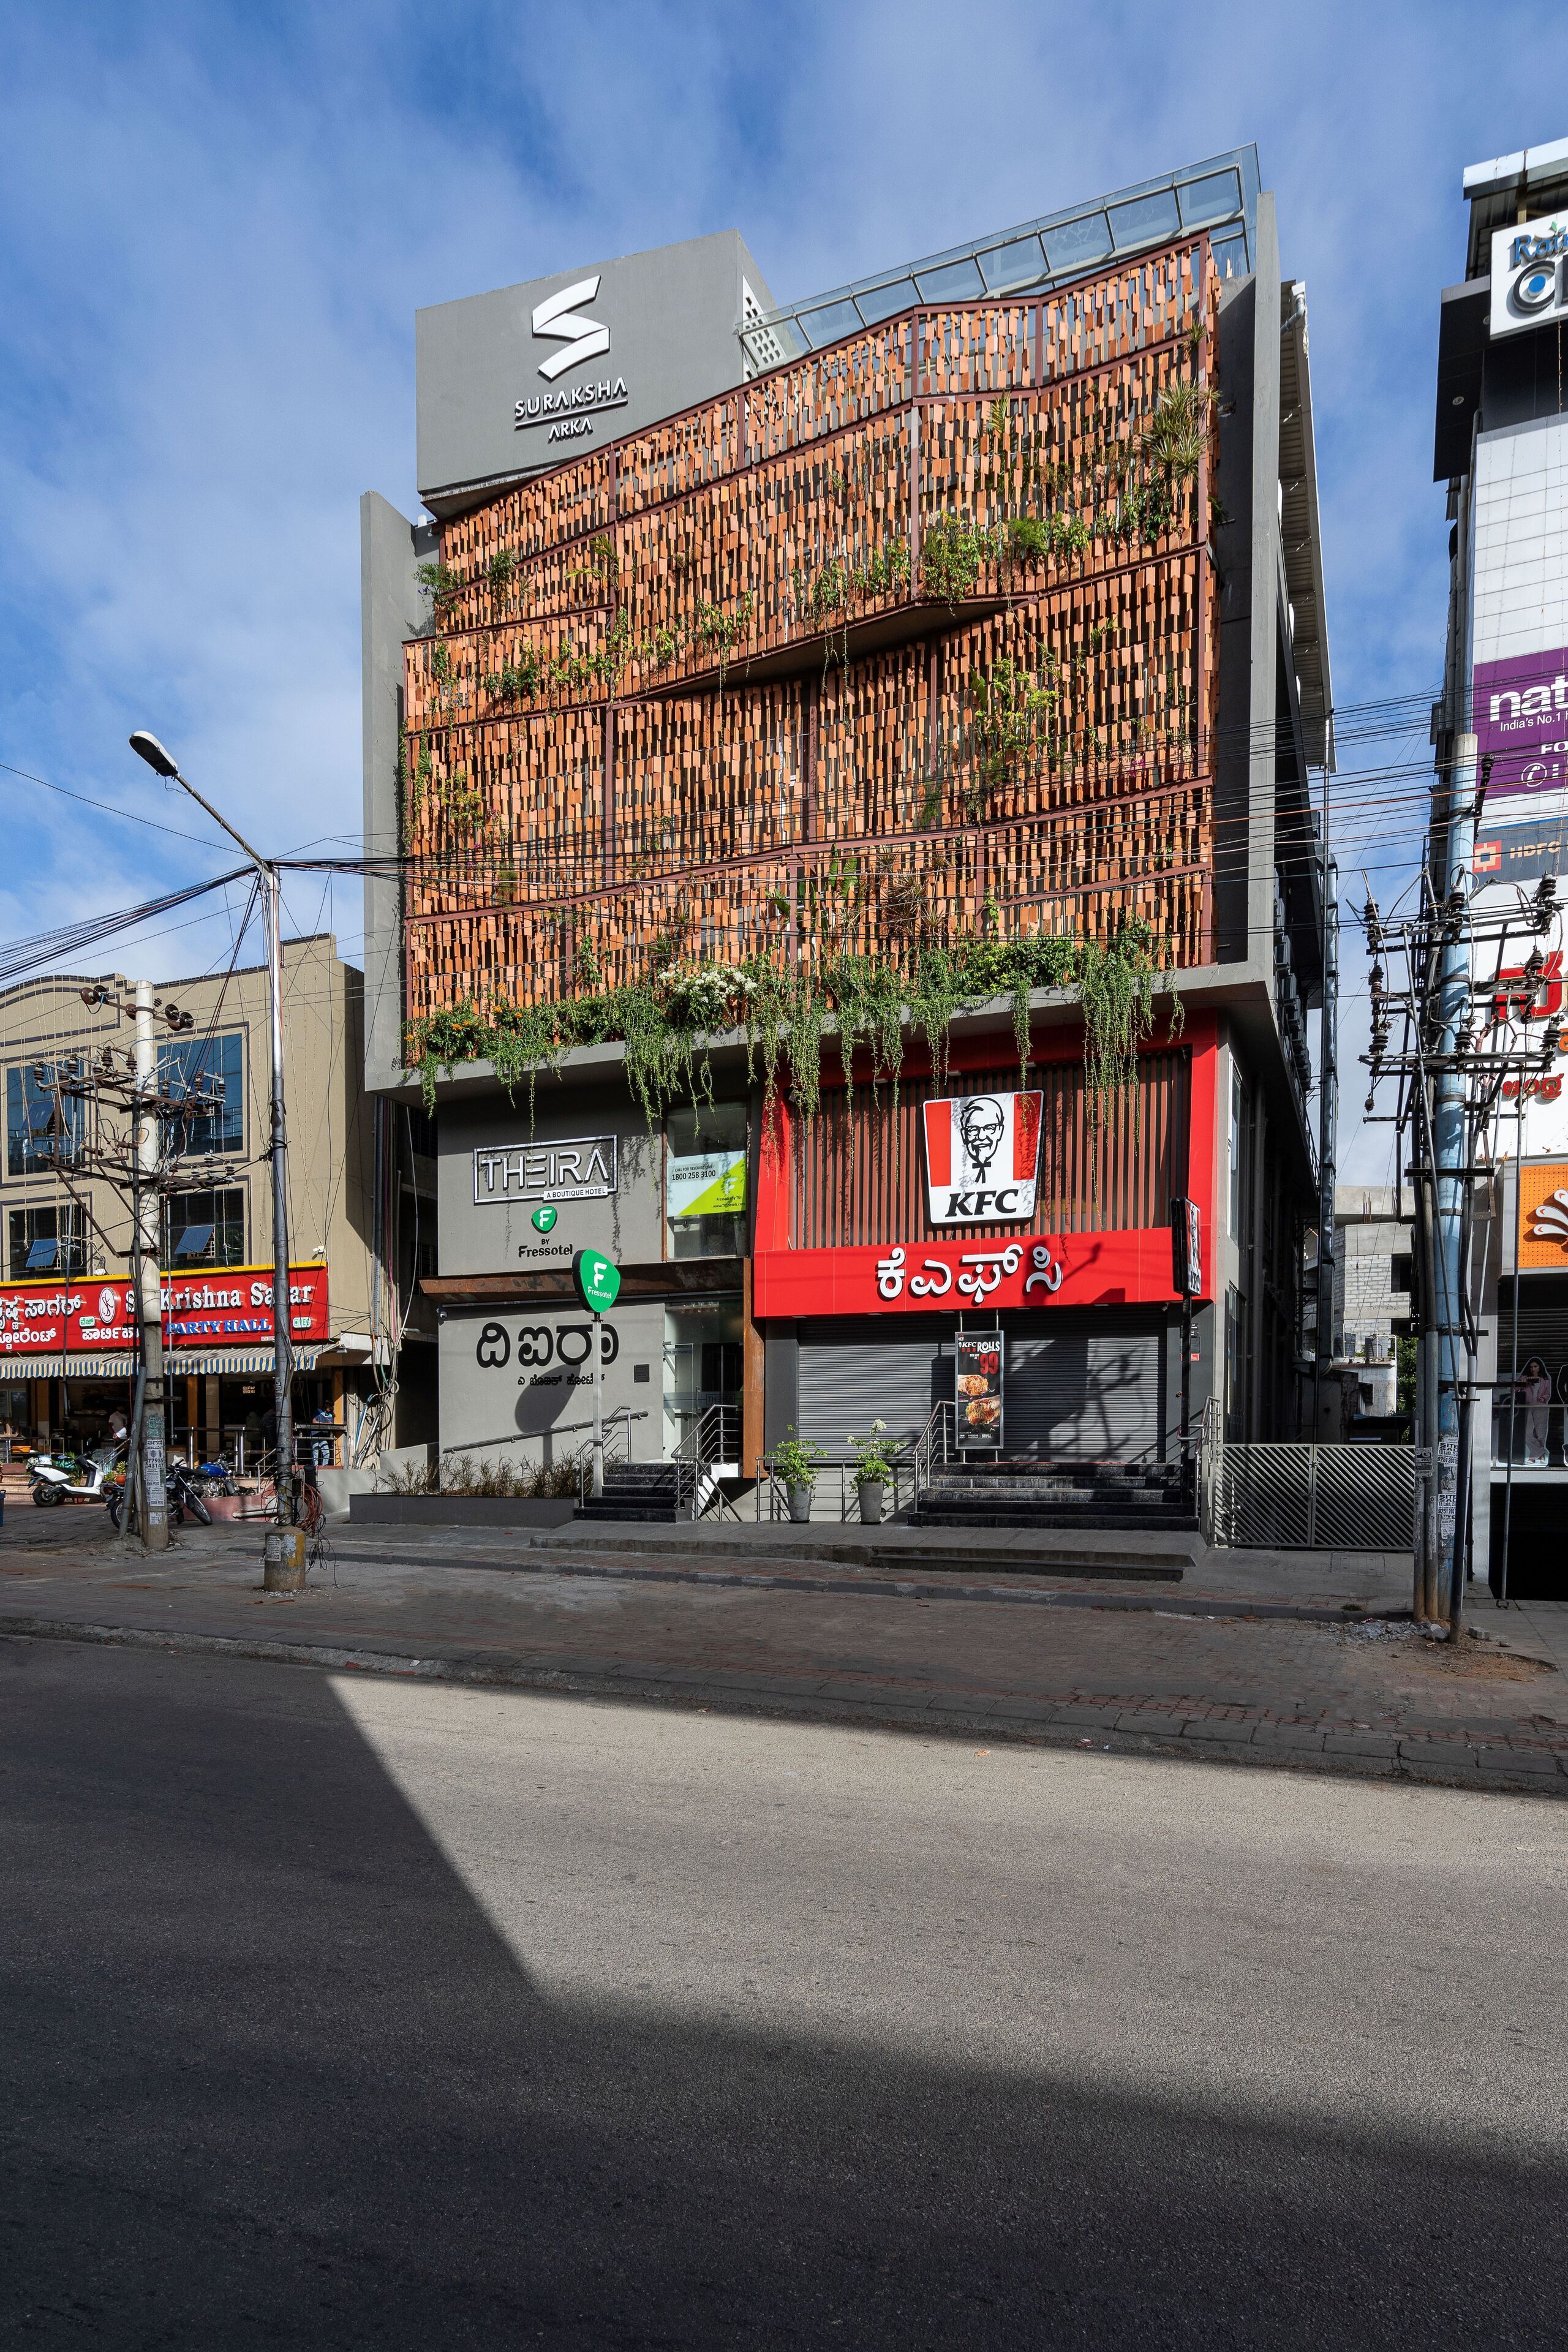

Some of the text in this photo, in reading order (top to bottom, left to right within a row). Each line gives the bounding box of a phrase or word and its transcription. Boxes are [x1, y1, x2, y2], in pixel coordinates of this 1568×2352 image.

[515, 377, 627, 417] SURAKSHA
[548, 418, 592, 440] ARKA
[1537, 712, 1561, 725] No.1
[1510, 841, 1561, 859] HDFC
[481, 1148, 609, 1190] THEIRA
[944, 1189, 1019, 1218] KFC
[539, 1210, 552, 1227] F
[518, 1243, 573, 1258] Fressotel
[594, 1262, 607, 1288] F
[1190, 1270, 1200, 1292] KFC
[160, 1284, 241, 1310] Krishna
[251, 1282, 312, 1306] Saar
[588, 1286, 612, 1299] Fressotel
[166, 1318, 273, 1335] PARTY HALL
[977, 1341, 1000, 1354] ROLLS
